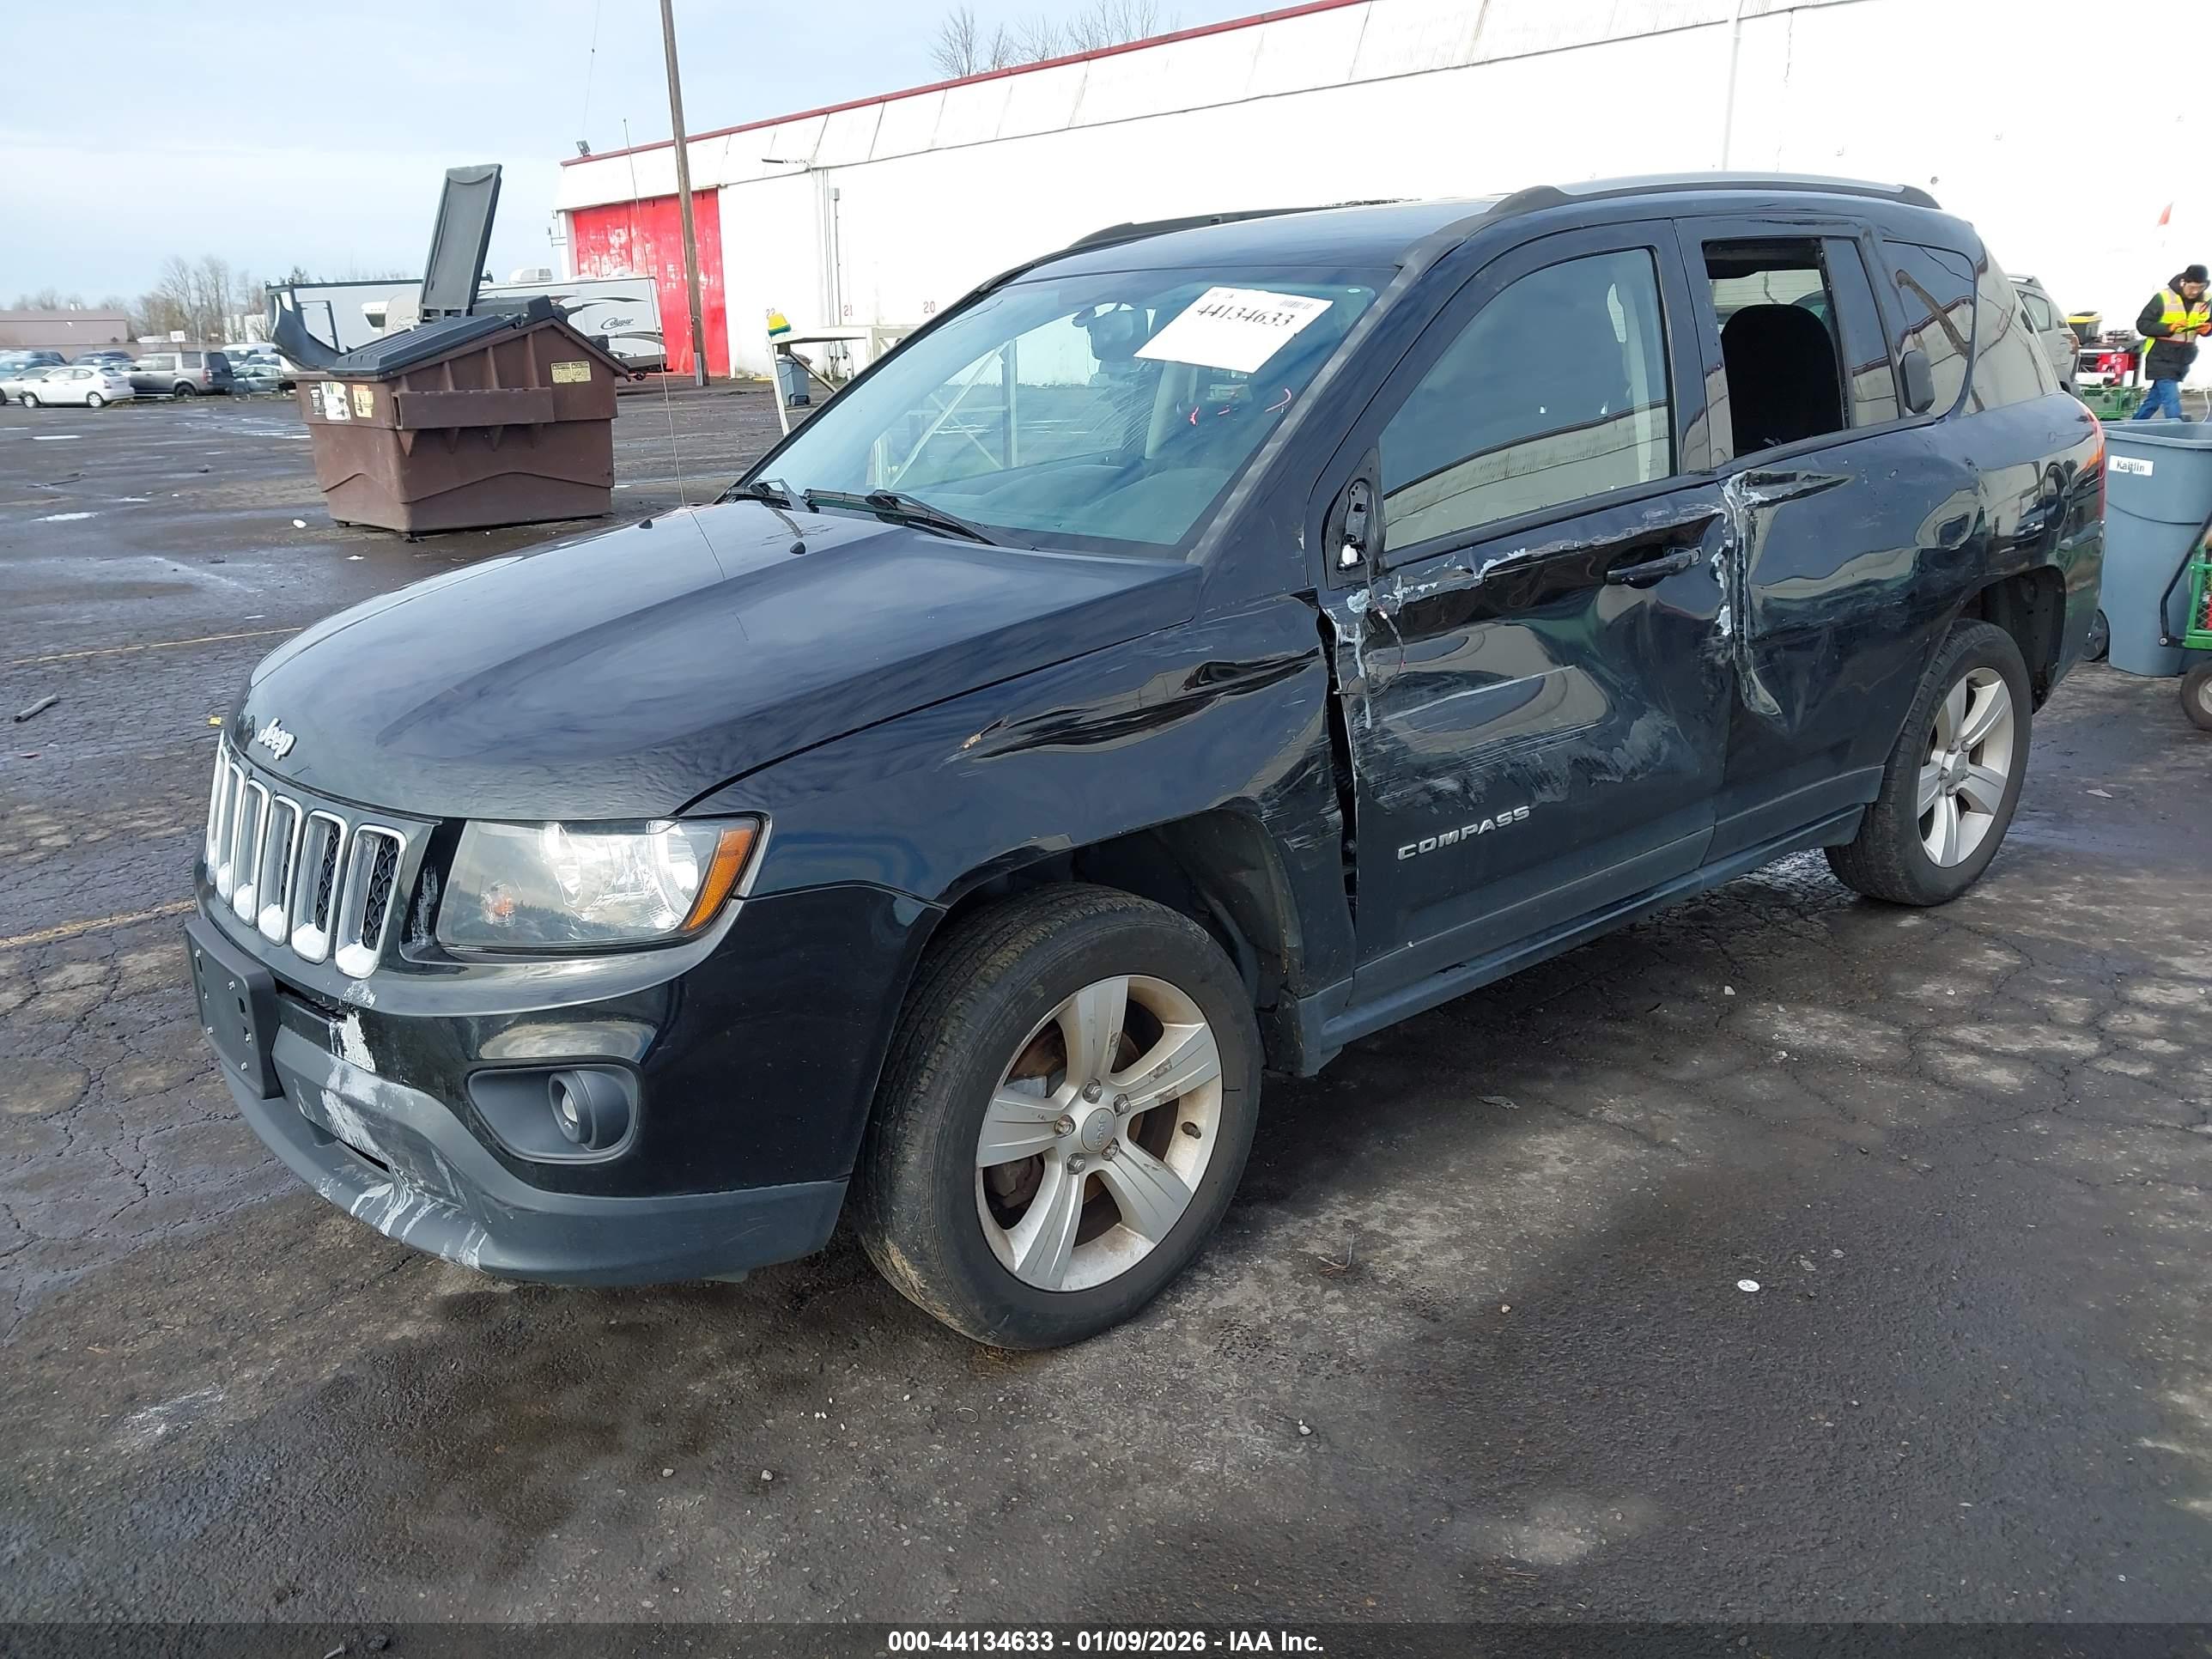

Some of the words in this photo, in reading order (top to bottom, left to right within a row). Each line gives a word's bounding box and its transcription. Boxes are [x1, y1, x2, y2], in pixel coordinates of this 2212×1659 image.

[843, 305, 854, 317] 21
[923, 301, 935, 313] 20
[1197, 304, 1295, 326] 44134633
[2117, 459, 2145, 472] Kaitlin
[258, 717, 295, 760] Jeep
[1397, 805, 1530, 860] COMPASS
